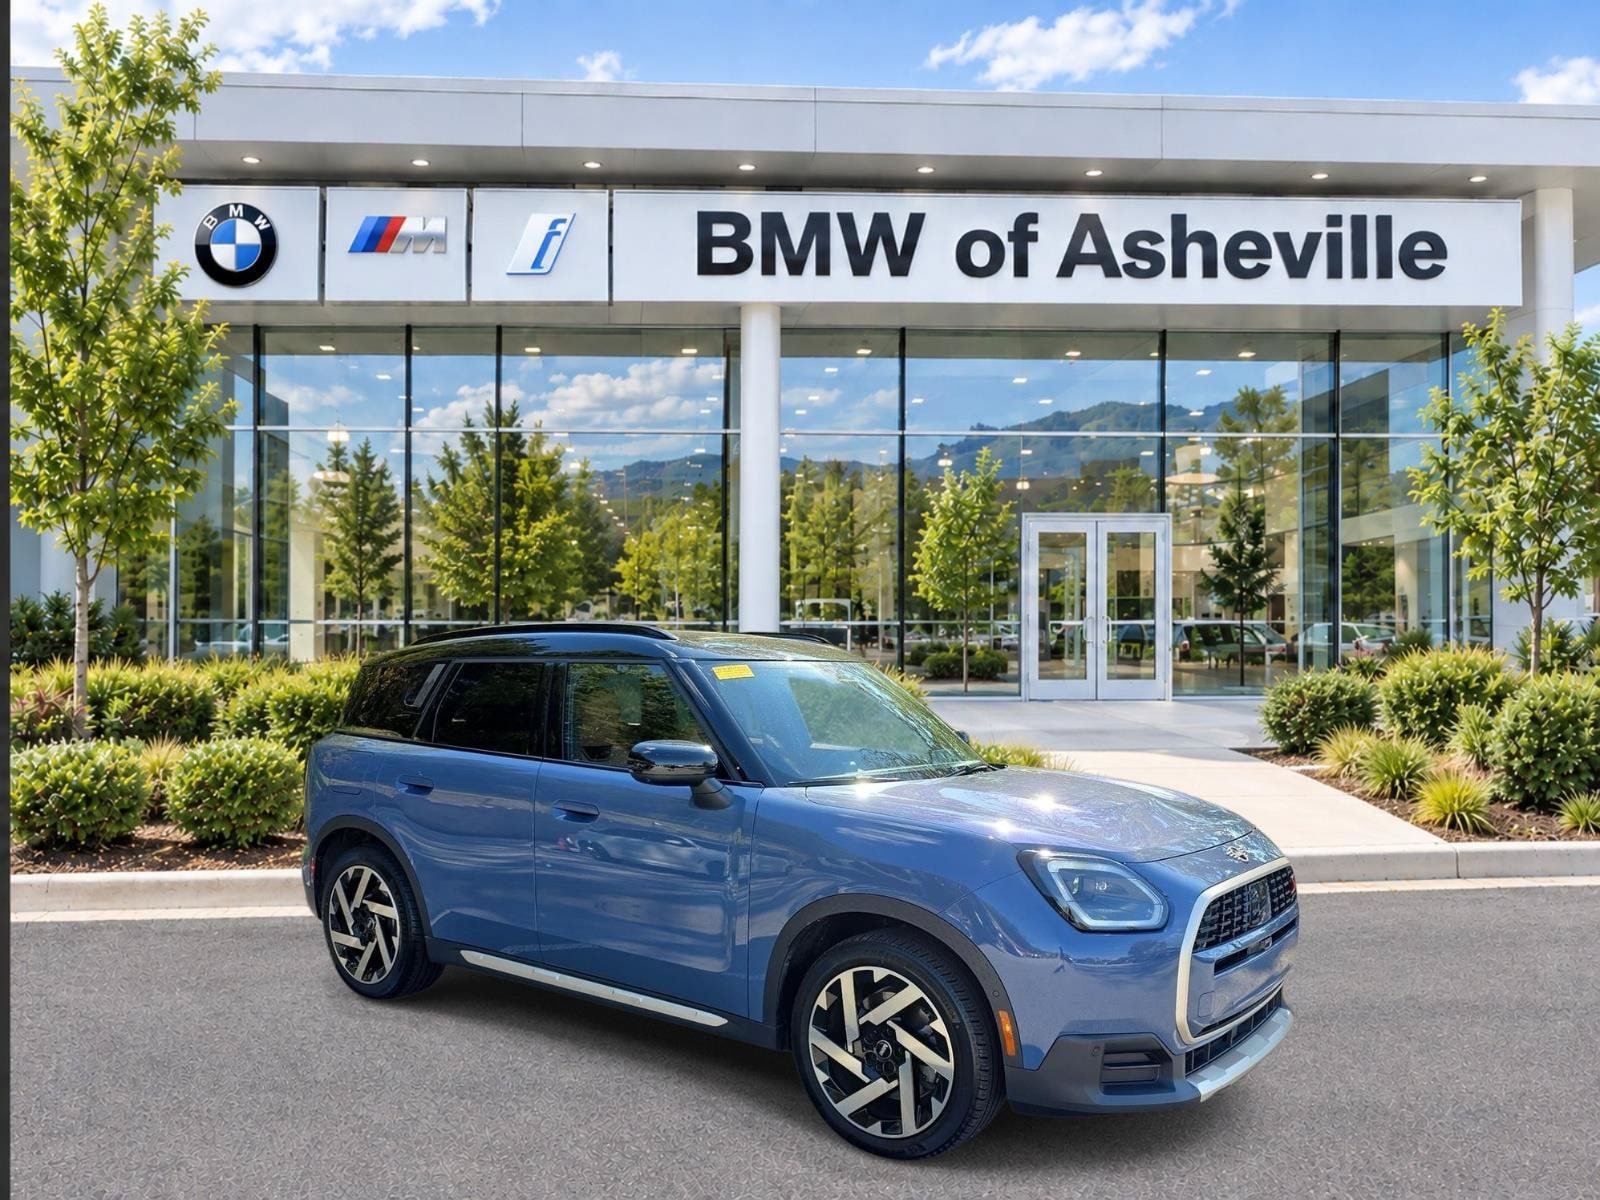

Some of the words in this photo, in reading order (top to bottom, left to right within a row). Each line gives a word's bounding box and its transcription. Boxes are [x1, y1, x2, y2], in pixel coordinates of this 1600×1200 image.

[202, 204, 271, 231] BMW
[697, 210, 926, 277] BMW
[955, 212, 1040, 279] of
[1056, 213, 1449, 281] Asheville
